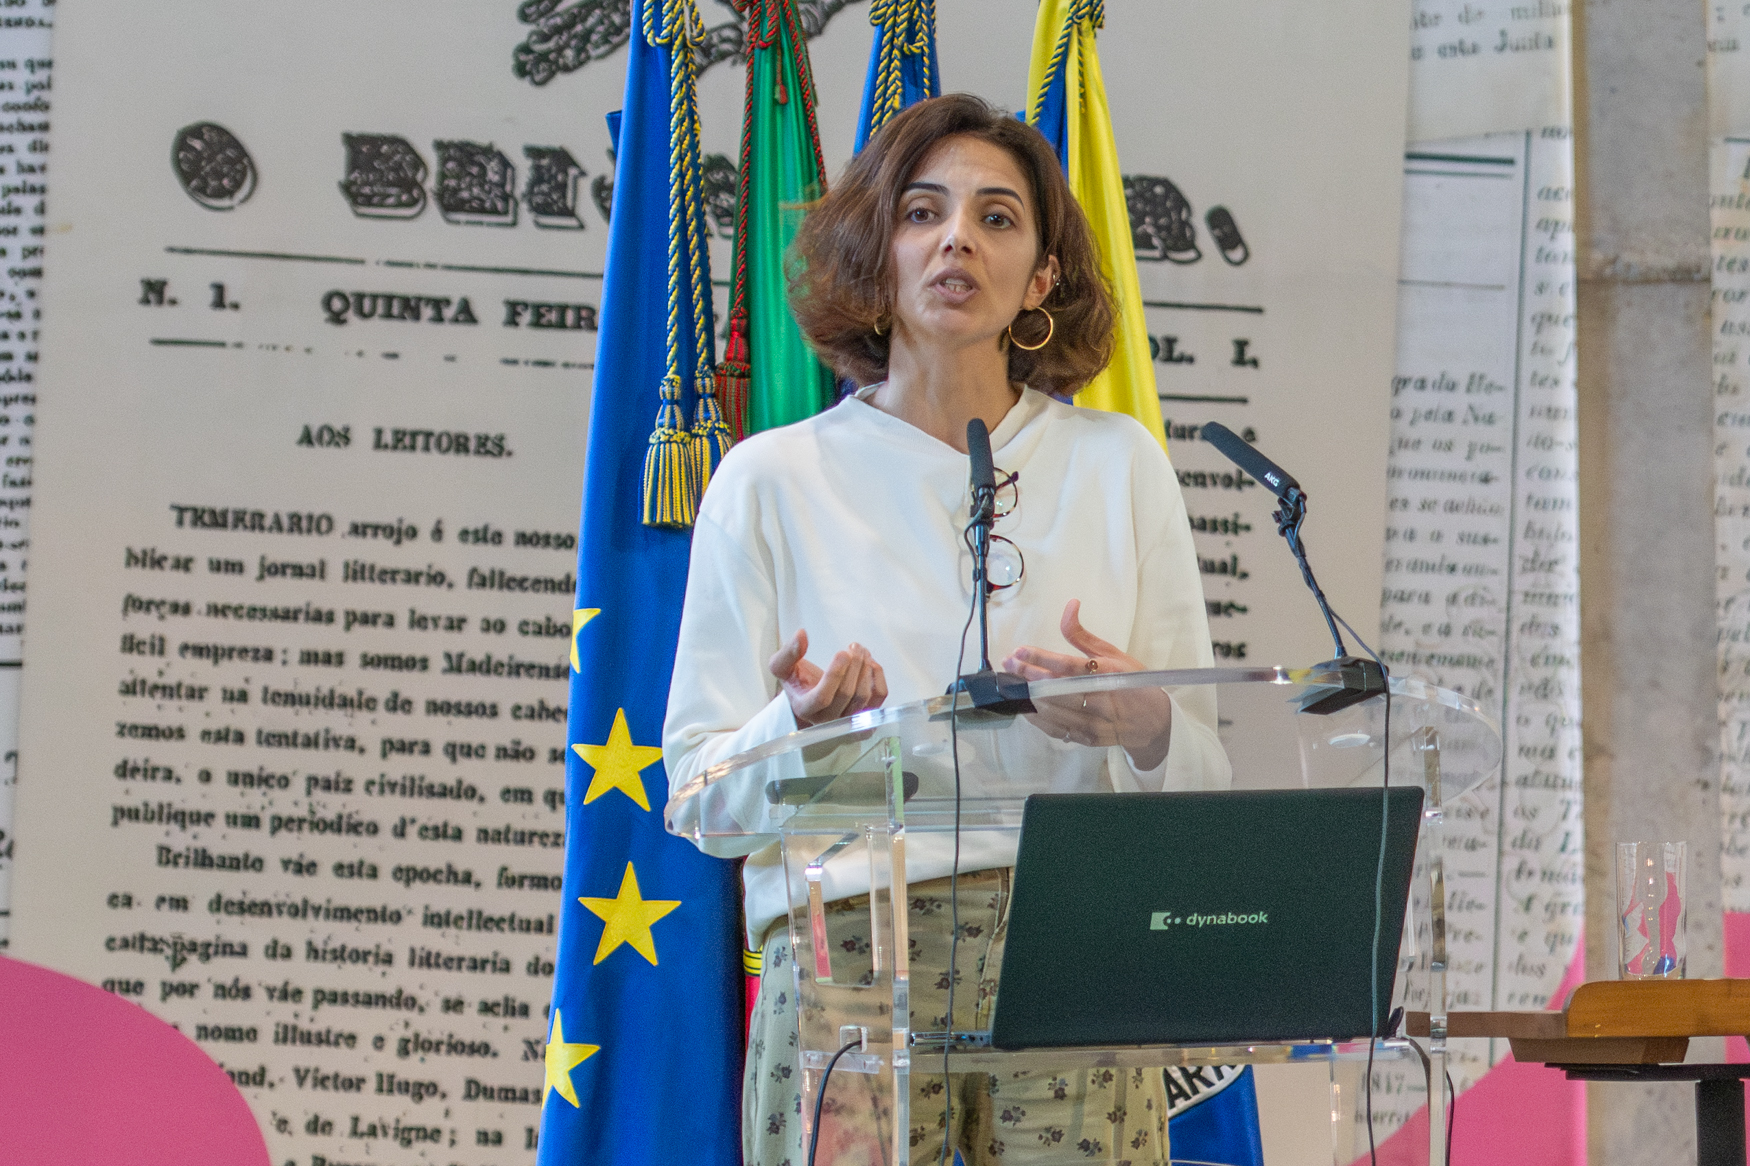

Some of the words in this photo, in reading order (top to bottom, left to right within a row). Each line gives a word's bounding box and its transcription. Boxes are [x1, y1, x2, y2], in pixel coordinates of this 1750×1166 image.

[320, 290, 479, 326] QUINTA
[297, 424, 351, 449] AOS
[372, 427, 514, 457] LEITORES.
[1264, 472, 1281, 487] AKG
[348, 517, 418, 546] arrojo
[513, 530, 576, 551] nosso
[207, 556, 244, 576] um
[255, 555, 326, 583] jornal
[343, 608, 395, 633] para
[408, 607, 467, 632] levar
[480, 616, 507, 635] ao
[517, 614, 573, 639] cabo
[177, 641, 275, 667] empreza
[298, 648, 346, 668] mas
[359, 652, 429, 673] somos
[385, 690, 413, 715] de
[425, 699, 499, 720] nossos
[115, 720, 187, 741] zemos
[200, 726, 246, 746] esta
[381, 738, 432, 762] para
[443, 741, 487, 766] que
[494, 738, 536, 763] não
[227, 765, 291, 790] unico
[305, 771, 355, 798] paiz
[364, 772, 485, 804] civilisado,
[500, 786, 534, 806] em
[110, 800, 216, 833] publique
[226, 811, 262, 830] um
[269, 812, 379, 838] periodico
[332, 857, 379, 881] esta
[391, 860, 482, 891] epocha,
[208, 892, 404, 927] desenvolvimento
[421, 904, 555, 936] intellectual
[1186, 909, 1270, 931] dynabook
[263, 937, 293, 961] da
[305, 937, 394, 969] historia
[408, 946, 512, 974] litteraria
[526, 954, 555, 977] do
[160, 979, 199, 1004] por
[213, 975, 253, 1001] nós
[196, 1024, 259, 1044] nome
[273, 1021, 358, 1049] illustre
[372, 1033, 386, 1052] e
[292, 1065, 367, 1093] Victor
[462, 1077, 542, 1104] Dumas
[305, 1112, 334, 1136] de
[349, 1115, 442, 1148] Lavigne
[475, 1128, 504, 1147] na
